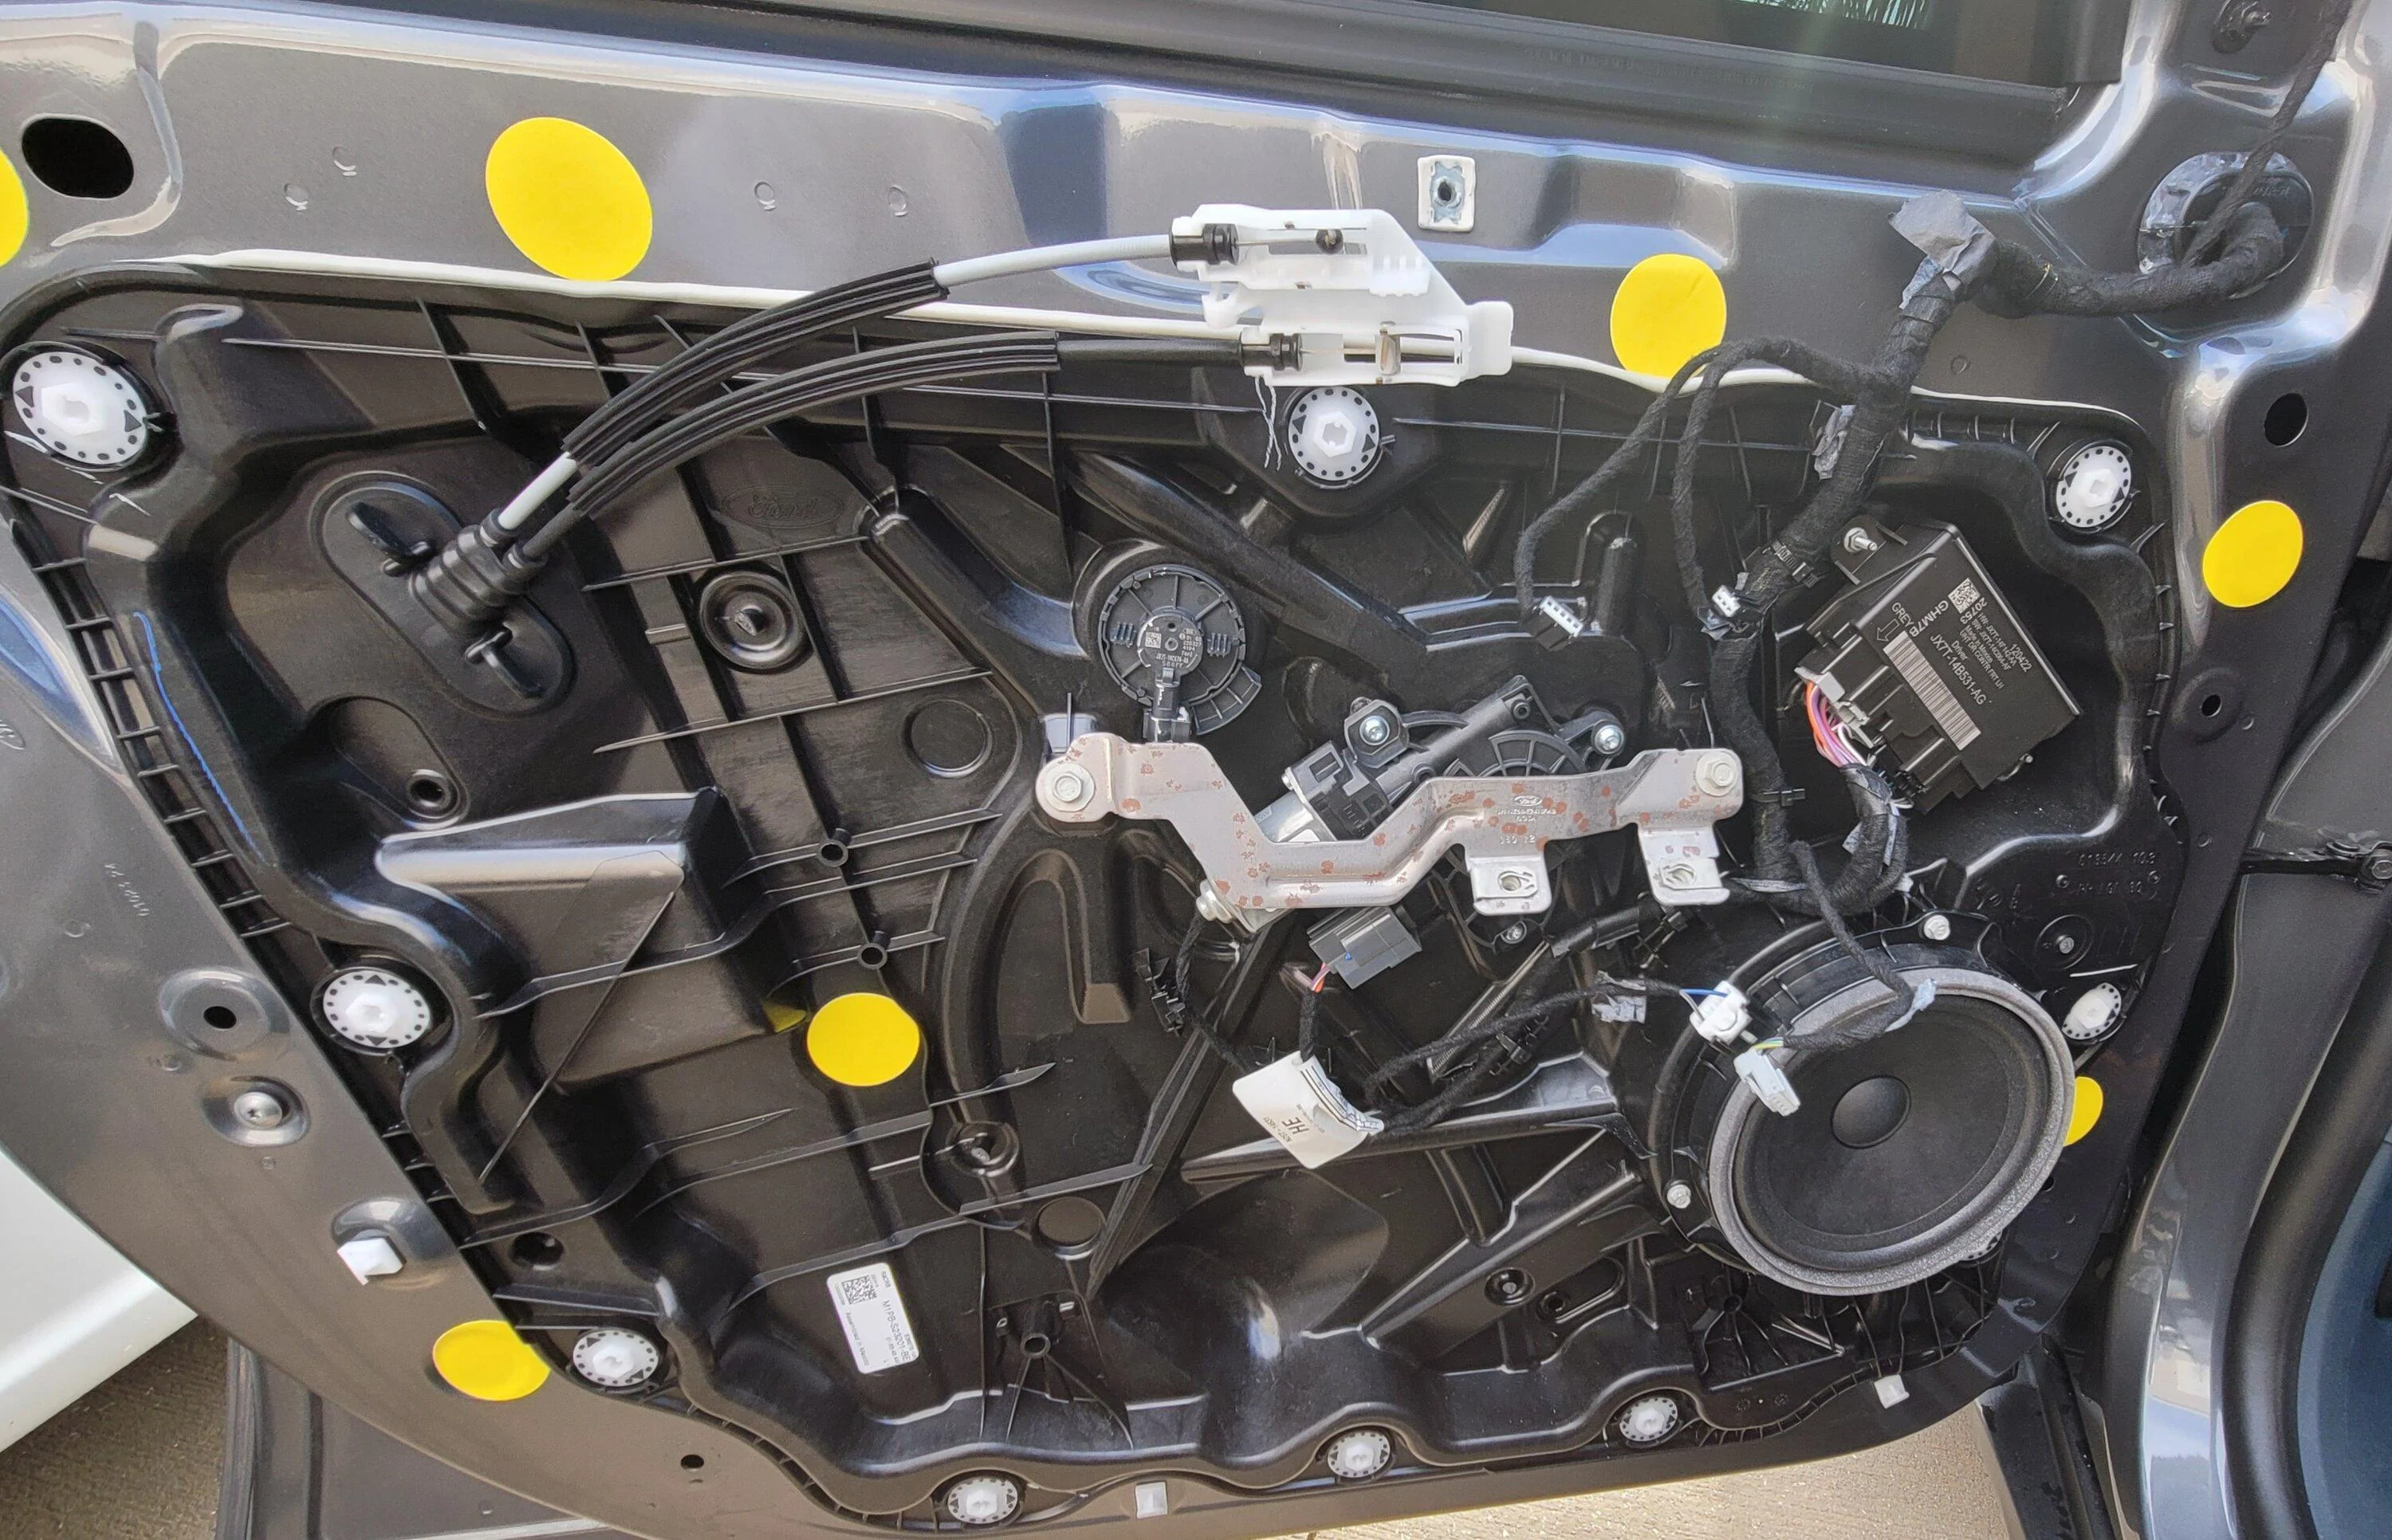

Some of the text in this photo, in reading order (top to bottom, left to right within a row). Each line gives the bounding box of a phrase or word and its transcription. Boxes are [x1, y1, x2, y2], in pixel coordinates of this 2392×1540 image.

[1890, 601, 1914, 628] GREY
[1958, 596, 1988, 625] 20753
[1950, 639, 1969, 661] Driver
[1964, 624, 1978, 641] Made
[1978, 643, 1994, 663] Mexico
[2008, 642, 2032, 672] 120422
[1930, 631, 1988, 705] JX7T-14B531-AG
[1282, 1117, 1309, 1134] HE
